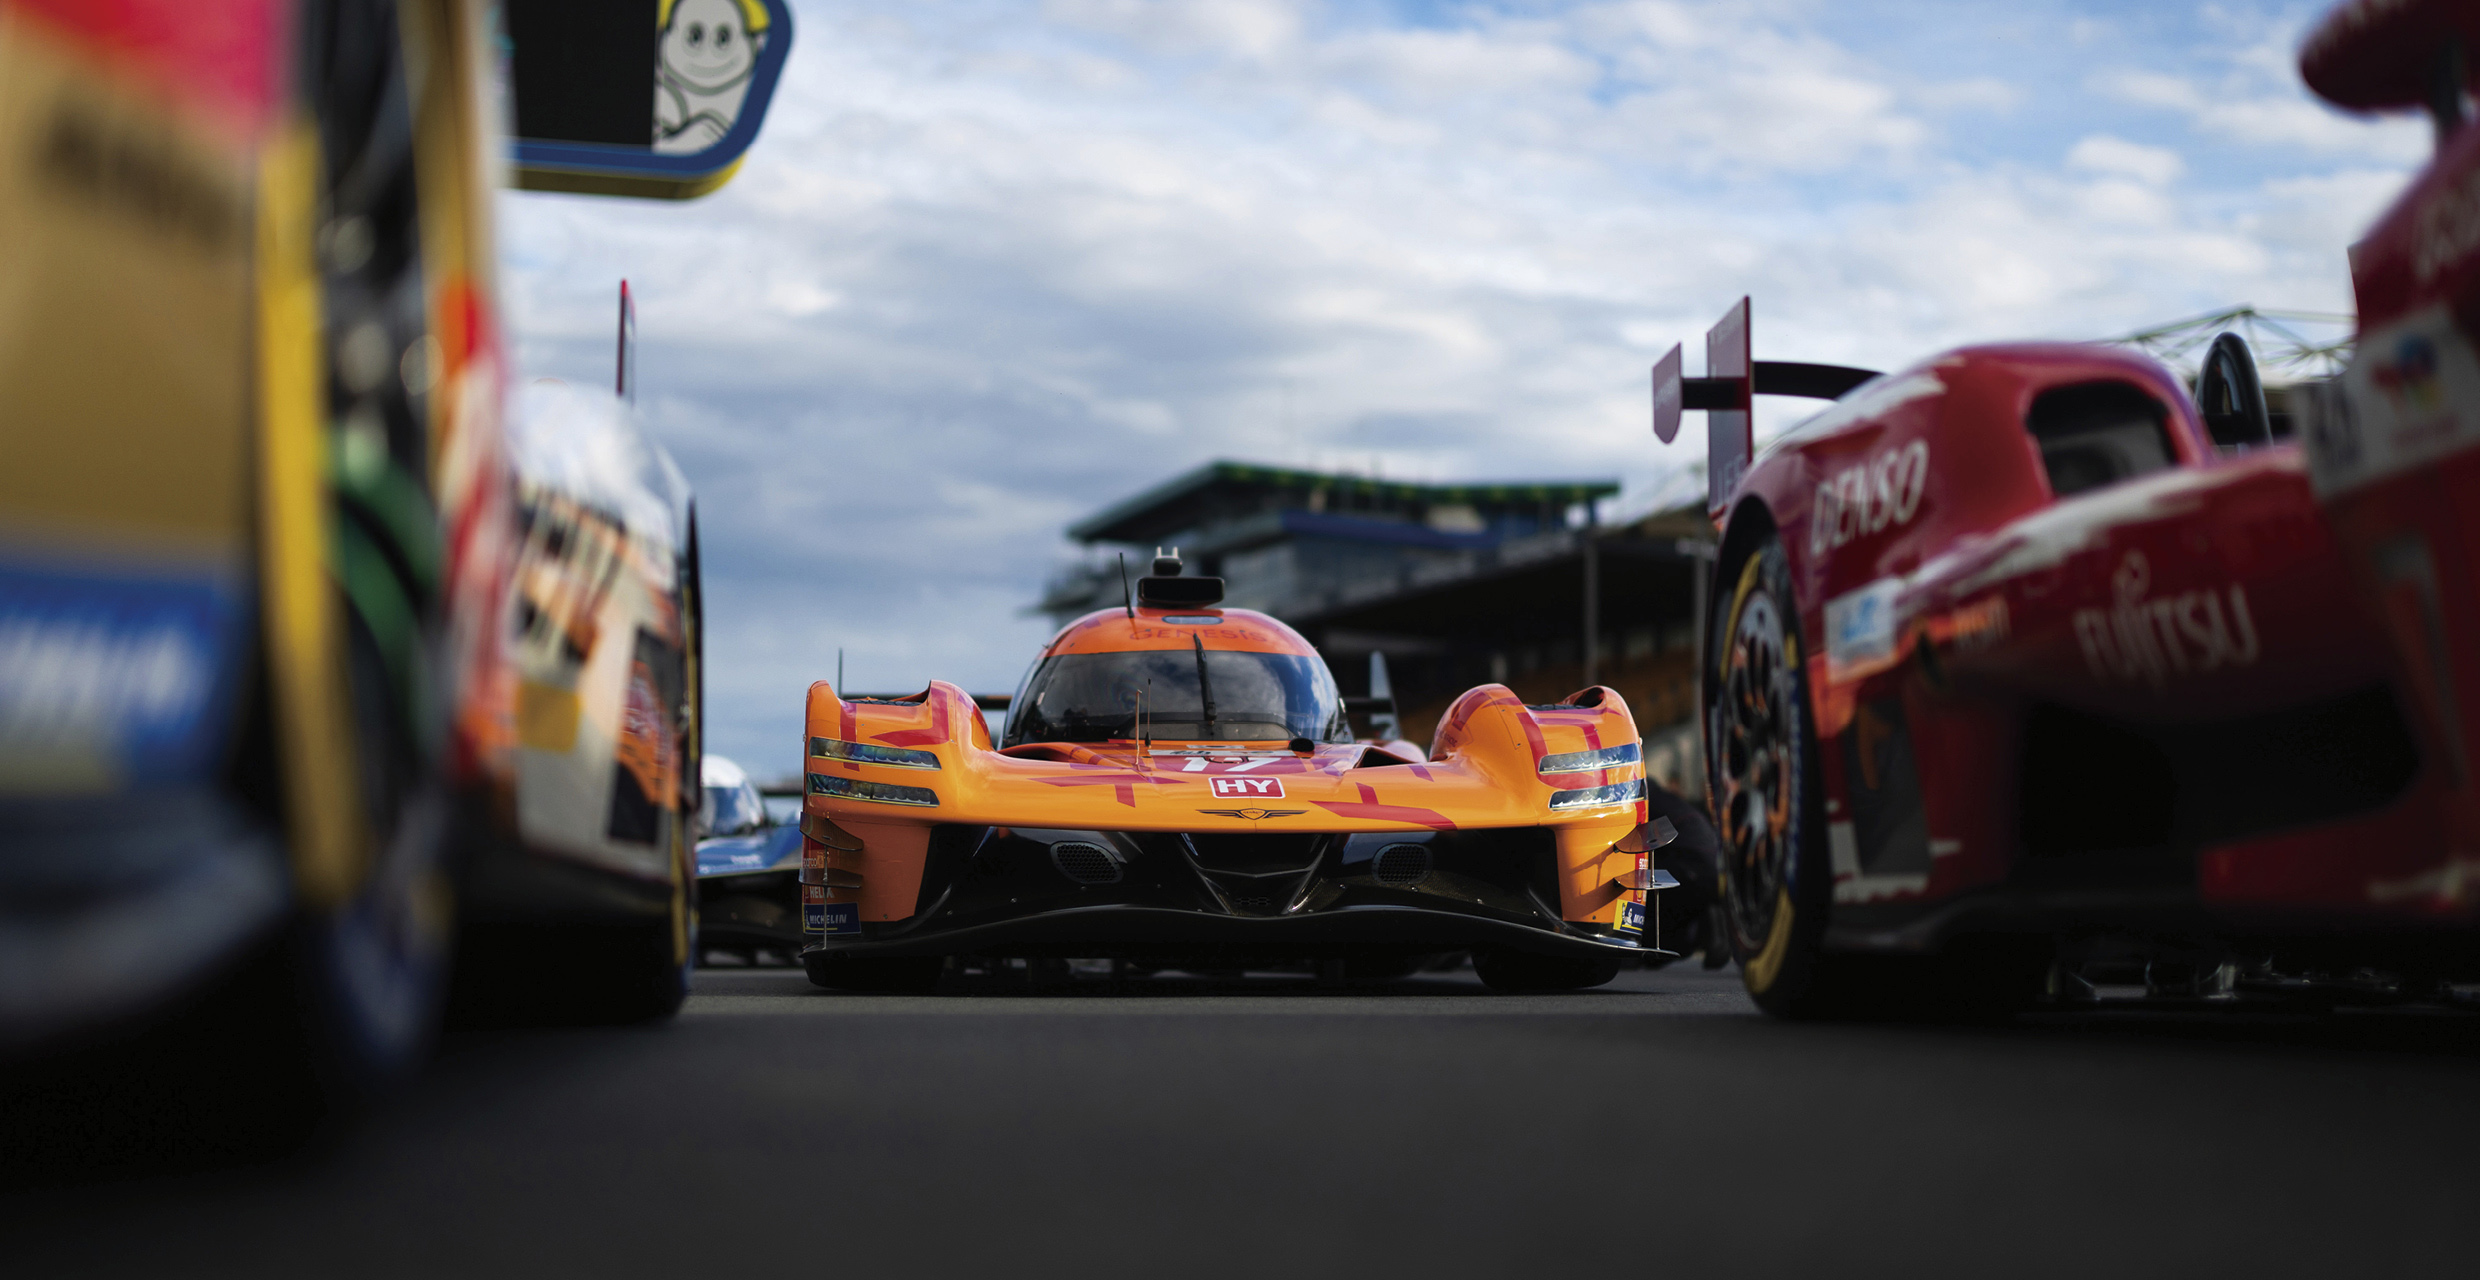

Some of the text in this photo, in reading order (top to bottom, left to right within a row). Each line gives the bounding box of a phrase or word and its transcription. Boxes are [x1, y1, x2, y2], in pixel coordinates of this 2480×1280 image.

[1811, 441, 1929, 556] DENSO
[1129, 629, 1267, 642] GENESIS
[1182, 757, 1282, 772] 17
[1216, 780, 1274, 793] HY
